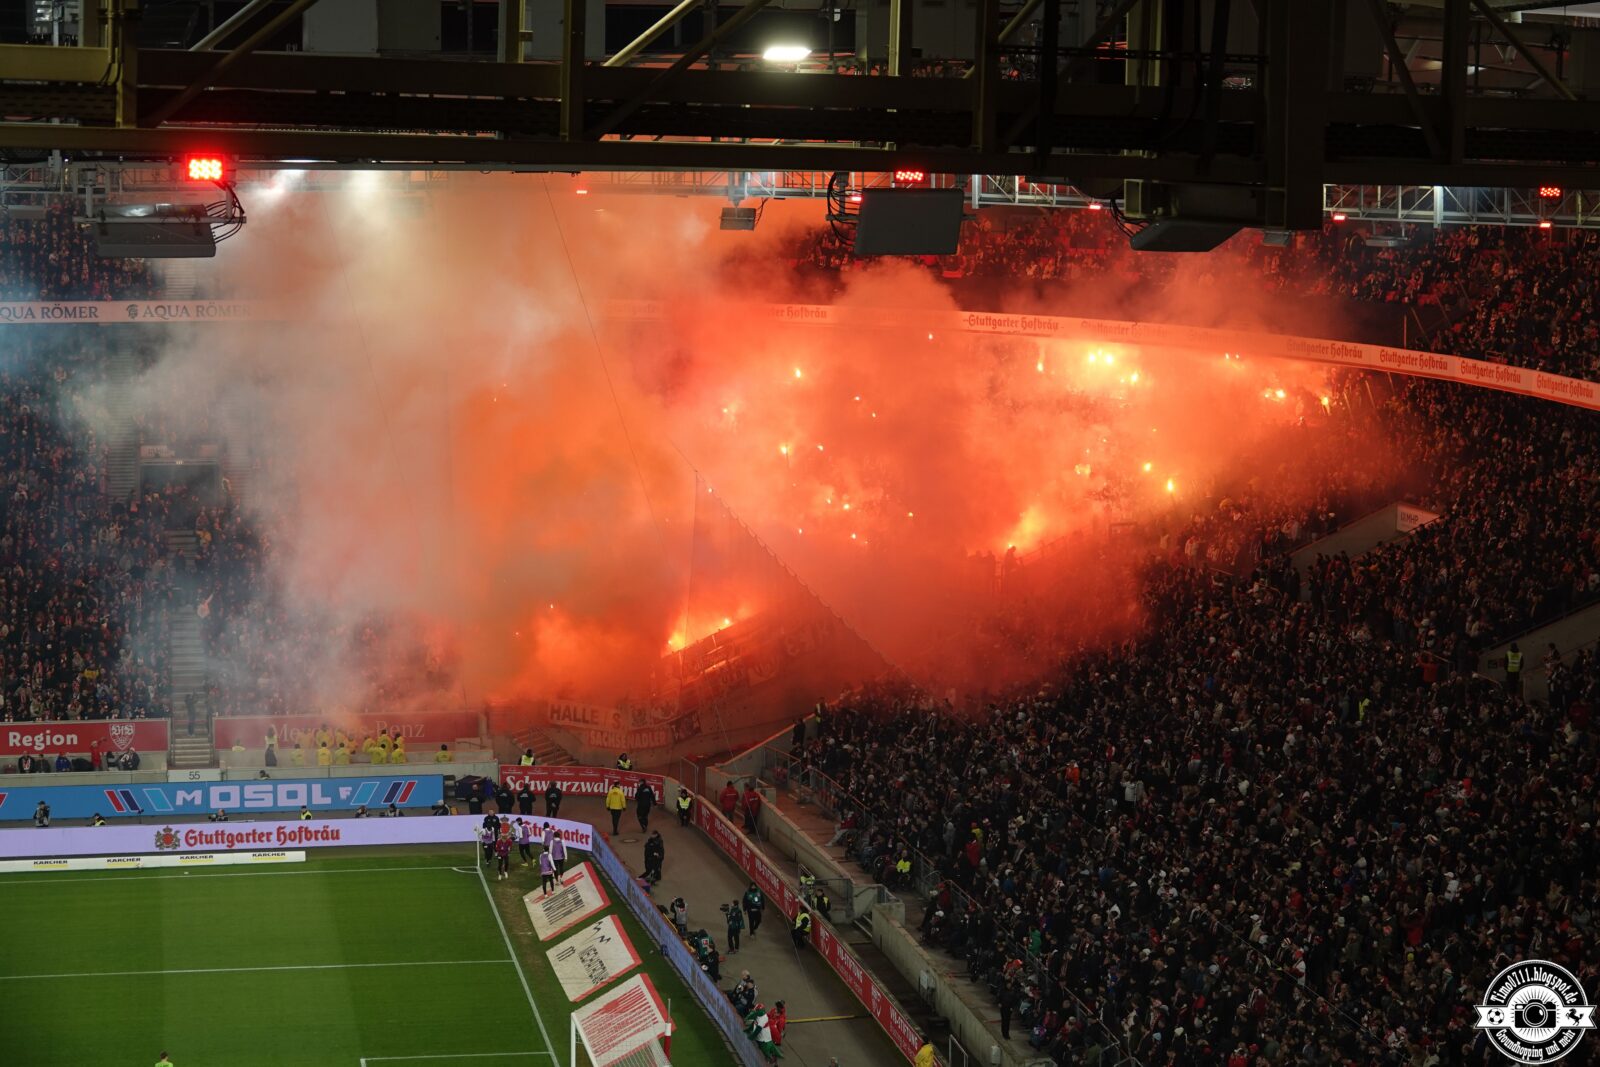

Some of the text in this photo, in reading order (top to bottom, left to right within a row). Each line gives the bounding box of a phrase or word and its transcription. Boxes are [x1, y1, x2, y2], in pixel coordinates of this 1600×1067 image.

[41, 303, 98, 319] RÖMER
[143, 302, 250, 320] AQUA RÖMER
[969, 314, 1059, 331] Stuttgarter Hofbräu
[1331, 343, 1363, 359] Hofbräu
[1380, 349, 1448, 370] Stuttgarter Hofbräu
[1460, 361, 1521, 384] Stuttgarter Hofbräu
[550, 703, 599, 725] HALLE
[8, 729, 78, 751] Region
[188, 771, 201, 780] 55
[175, 783, 352, 809] MOSOLF
[185, 825, 341, 848] Stuttgarter Hofbräu
